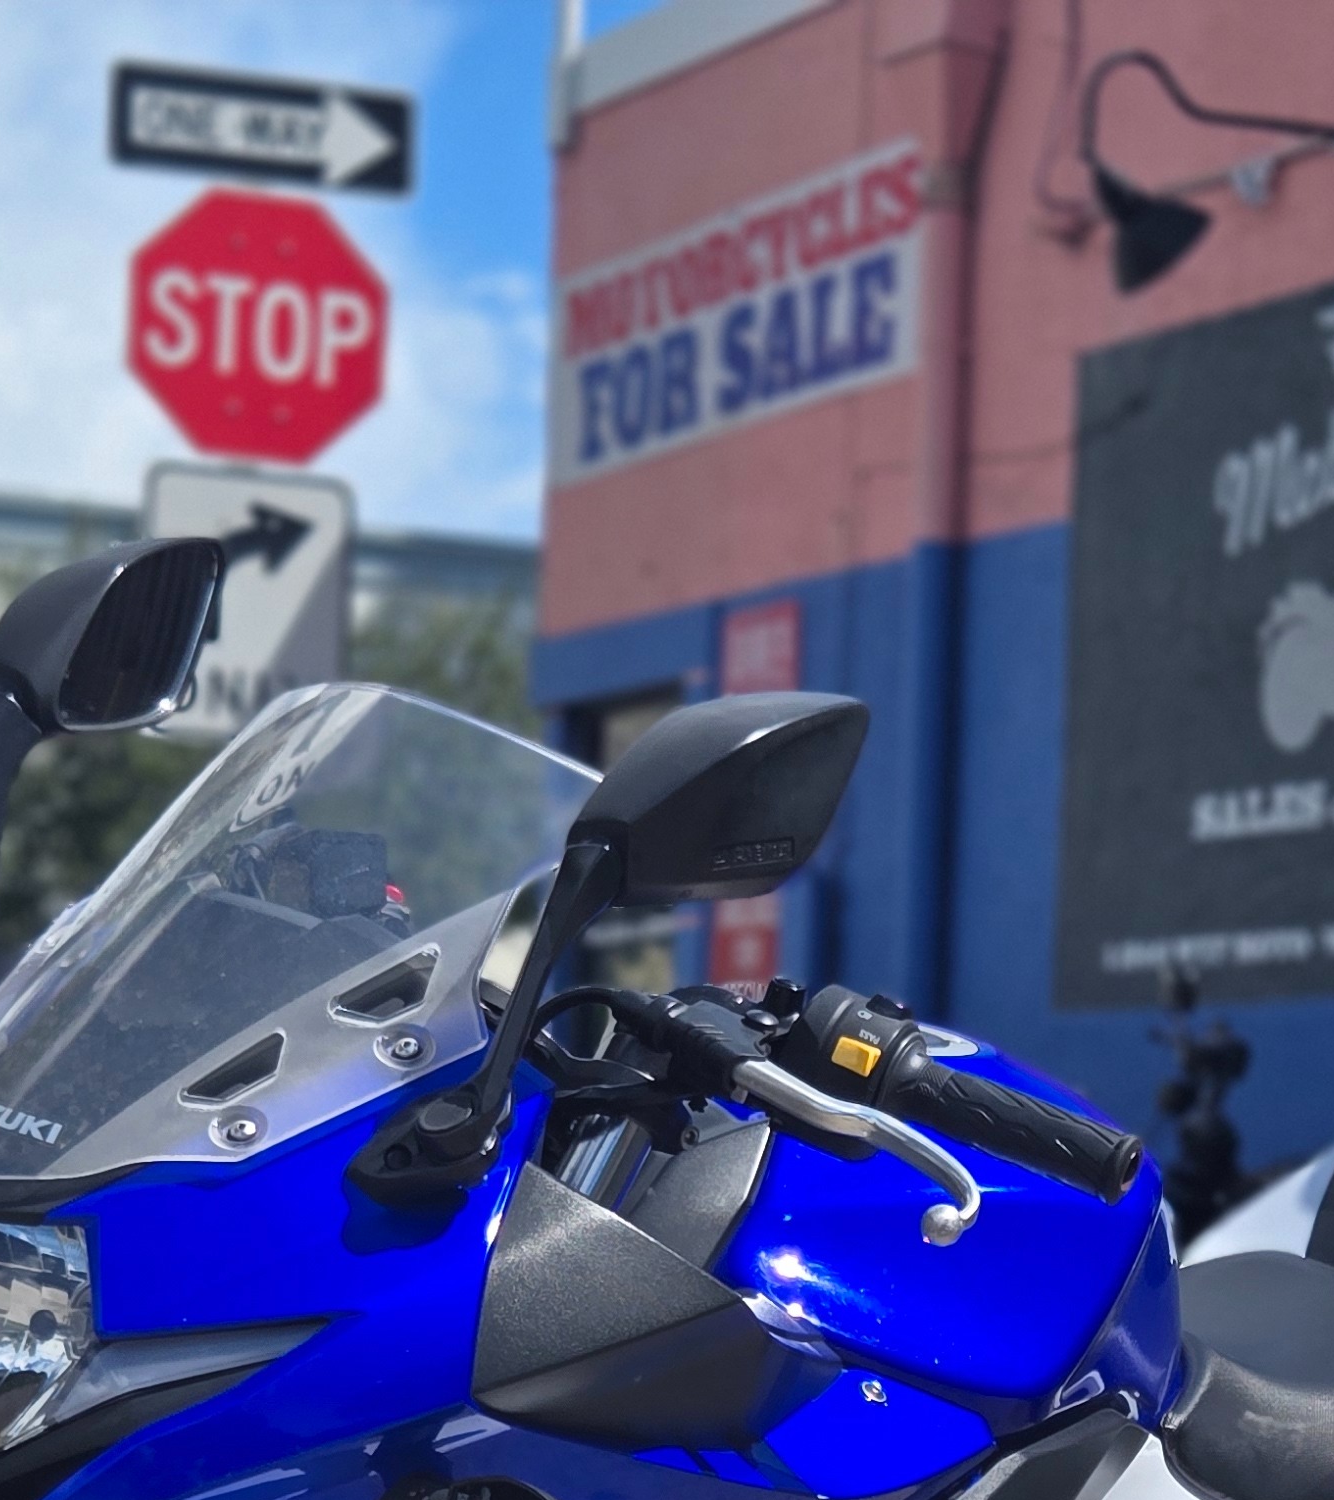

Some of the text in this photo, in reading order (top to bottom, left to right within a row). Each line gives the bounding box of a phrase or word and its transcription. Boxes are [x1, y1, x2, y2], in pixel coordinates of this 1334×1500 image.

[141, 94, 216, 146] ONE
[567, 154, 922, 360] MOTORCYCLES
[144, 268, 371, 388] STOP
[579, 250, 896, 464] FOR SALE
[1191, 779, 1326, 843] SALES
